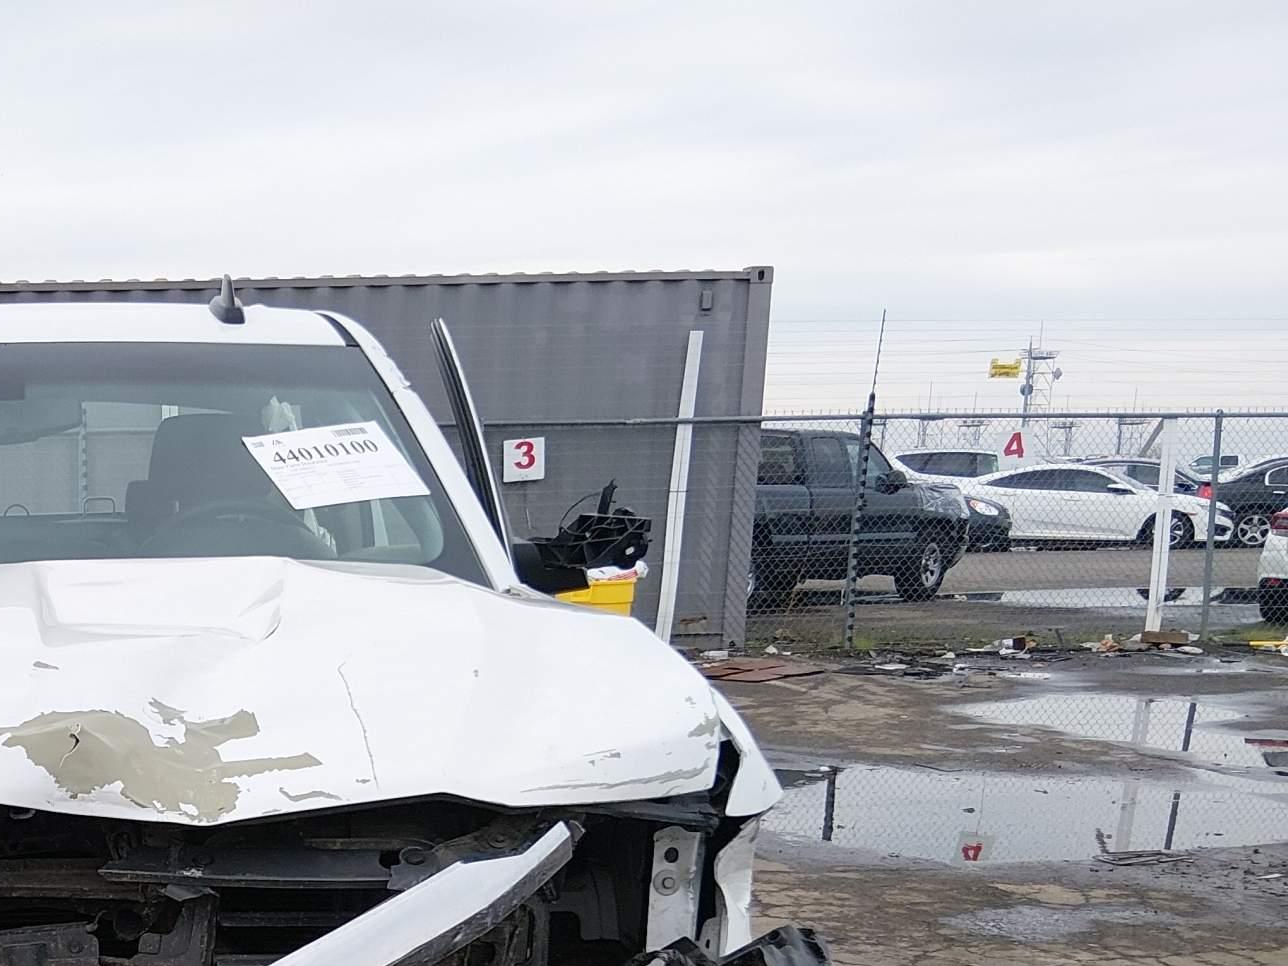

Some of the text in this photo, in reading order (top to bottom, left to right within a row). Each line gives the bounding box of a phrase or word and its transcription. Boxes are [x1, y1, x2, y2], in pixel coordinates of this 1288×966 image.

[273, 439, 379, 464] 44010100
[514, 441, 536, 470] 3
[1003, 431, 1025, 459] 4
